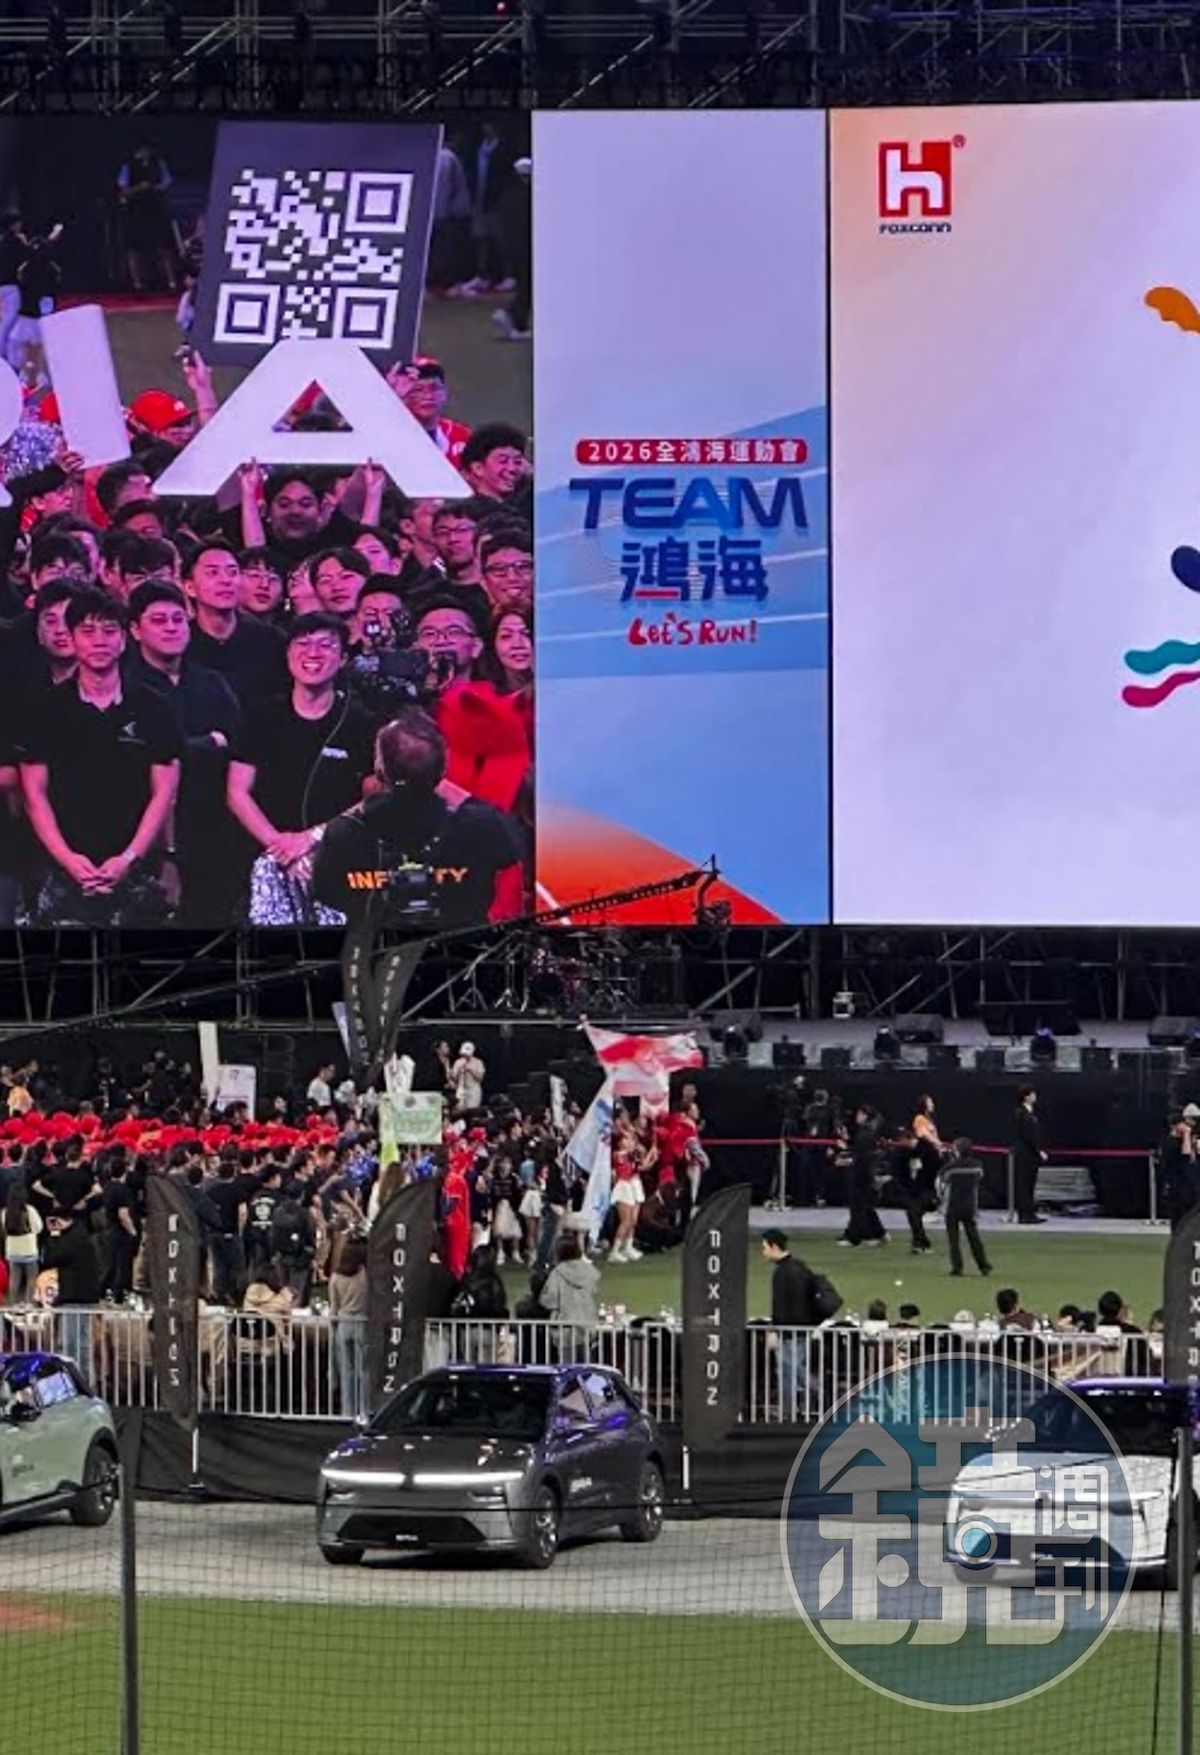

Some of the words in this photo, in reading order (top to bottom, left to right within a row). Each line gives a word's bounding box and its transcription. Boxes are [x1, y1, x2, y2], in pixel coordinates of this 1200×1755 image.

[879, 222, 952, 234] FOXCONN
[569, 477, 808, 529] TEAM
[620, 535, 768, 602] 鴻海
[705, 1229, 722, 1406] FOXTRON
